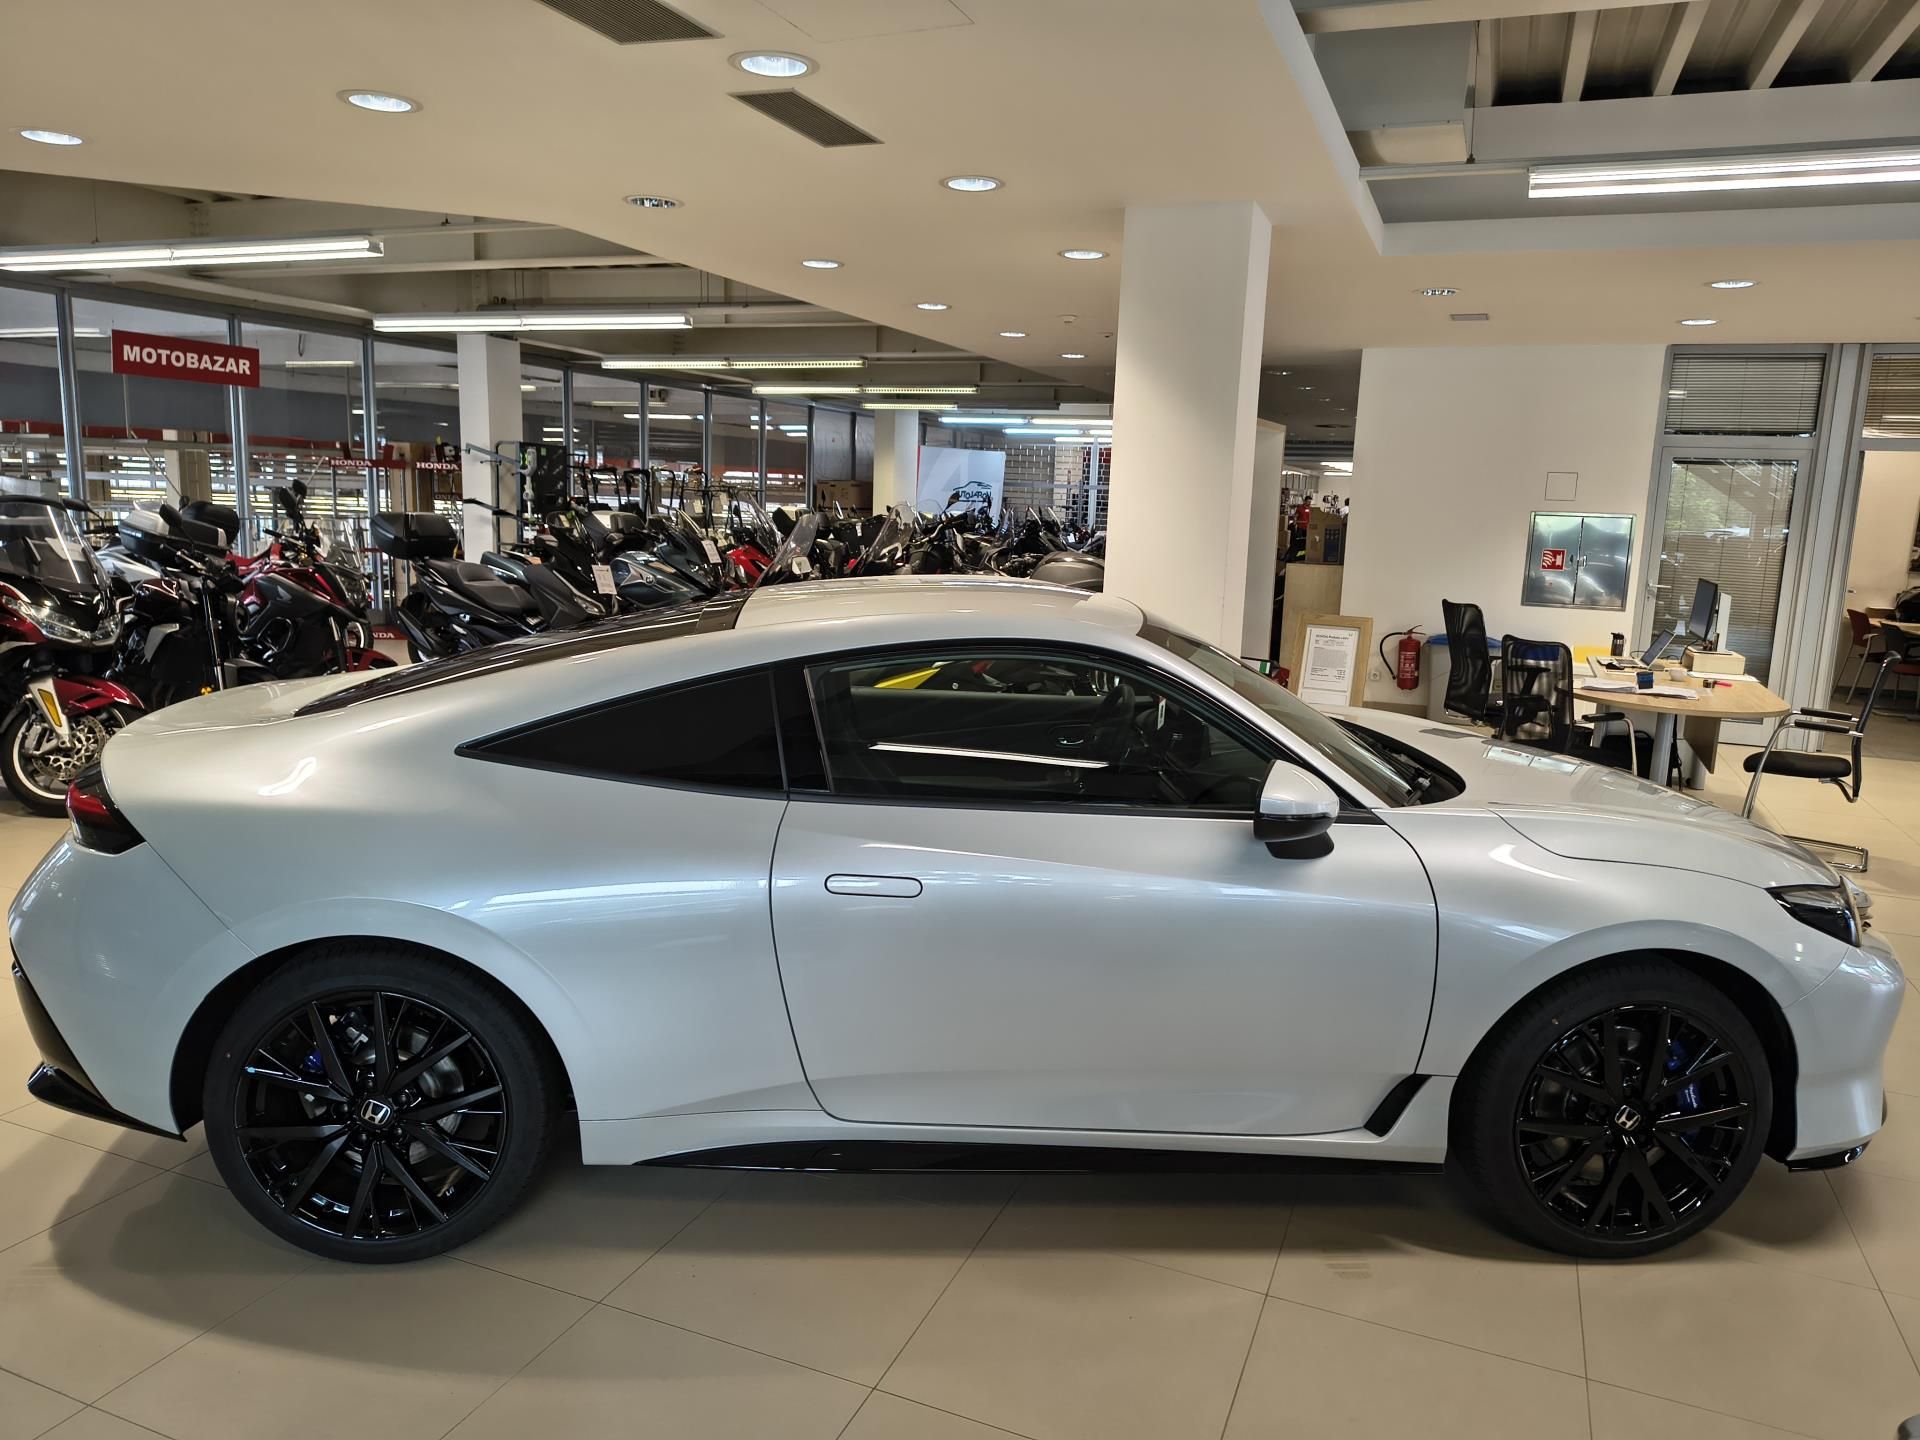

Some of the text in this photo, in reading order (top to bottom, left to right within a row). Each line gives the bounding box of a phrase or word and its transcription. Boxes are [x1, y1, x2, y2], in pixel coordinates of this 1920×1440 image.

[122, 344, 252, 376] MOTOBAZAR
[330, 459, 373, 467] HONDA
[416, 461, 460, 470] HONDA
